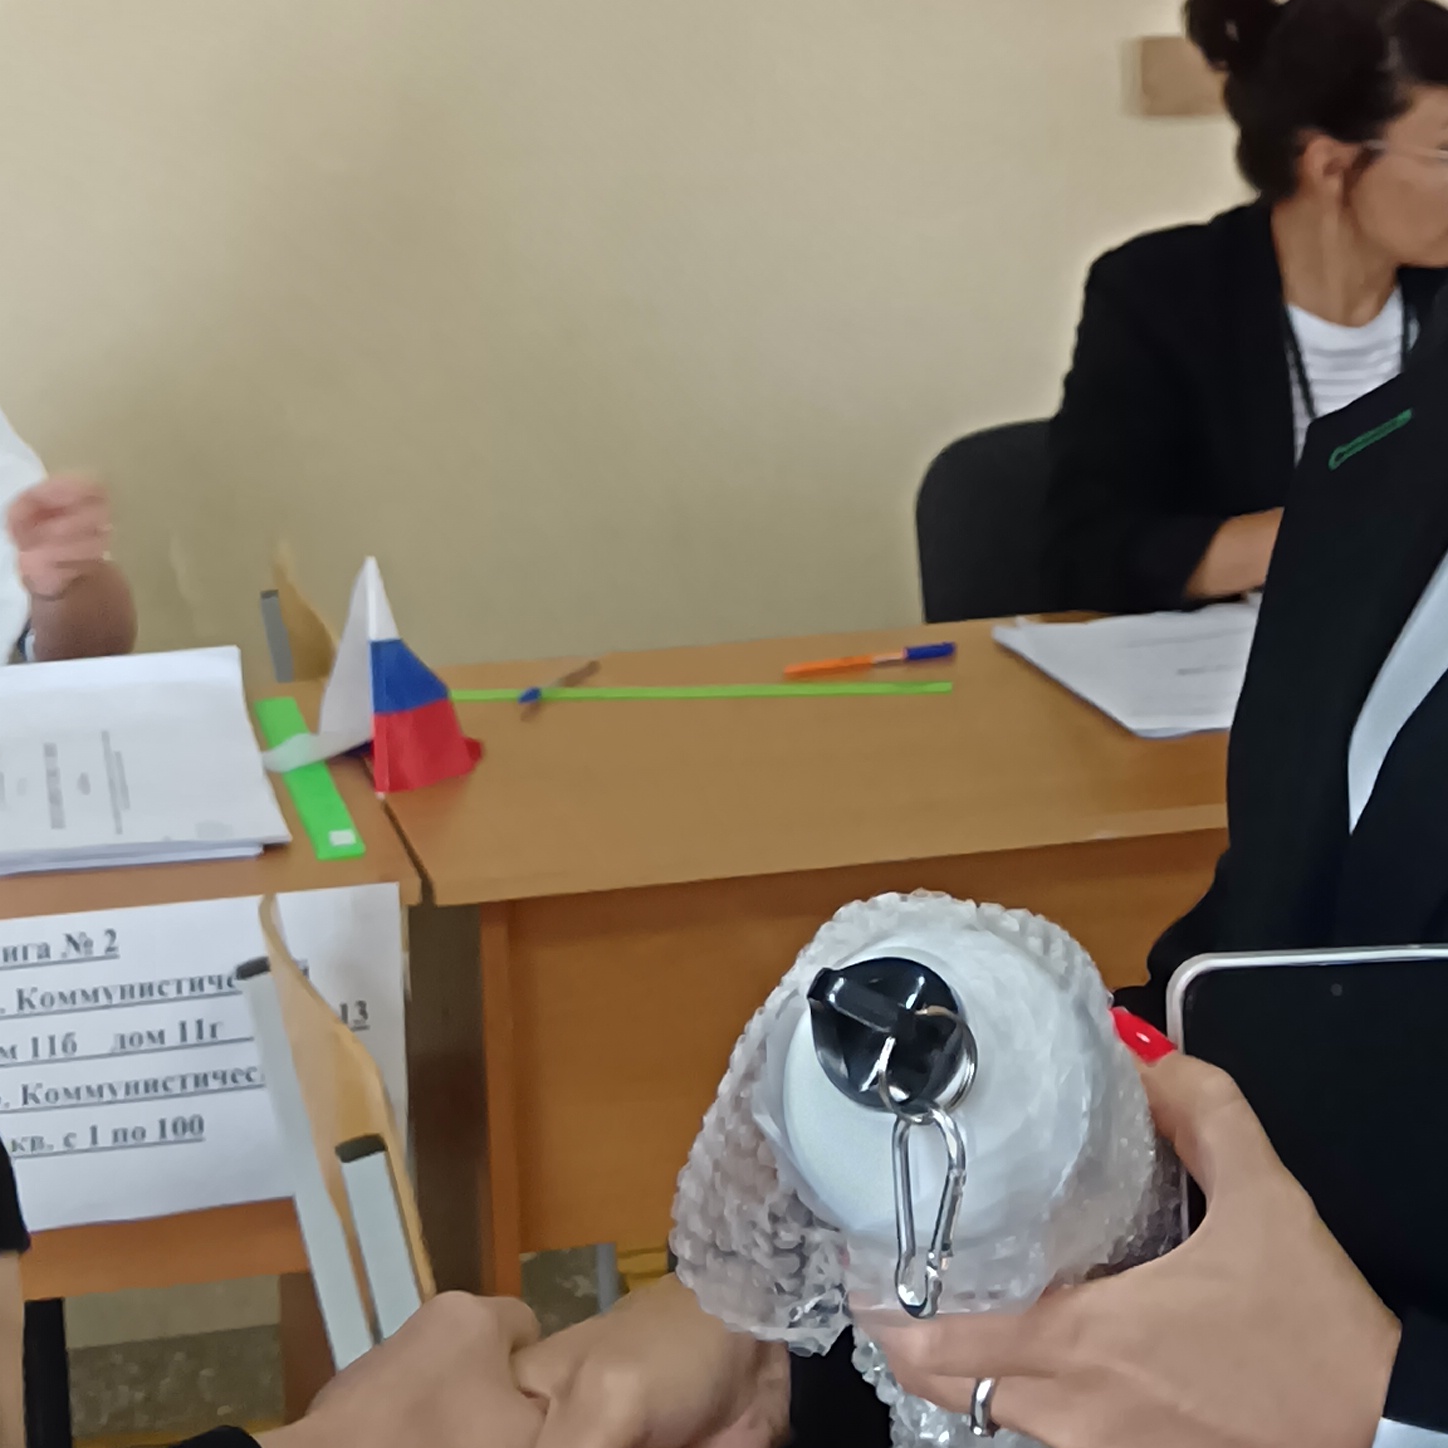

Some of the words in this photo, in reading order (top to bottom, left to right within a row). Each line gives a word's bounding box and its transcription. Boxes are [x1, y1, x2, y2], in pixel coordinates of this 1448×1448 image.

[103, 928, 119, 956] 2
[111, 1027, 166, 1052] дом
[20, 1065, 264, 1107] Коммунистичес
[89, 1124, 99, 1147] 1
[111, 1124, 147, 1144] по
[157, 1113, 206, 1141] 100
